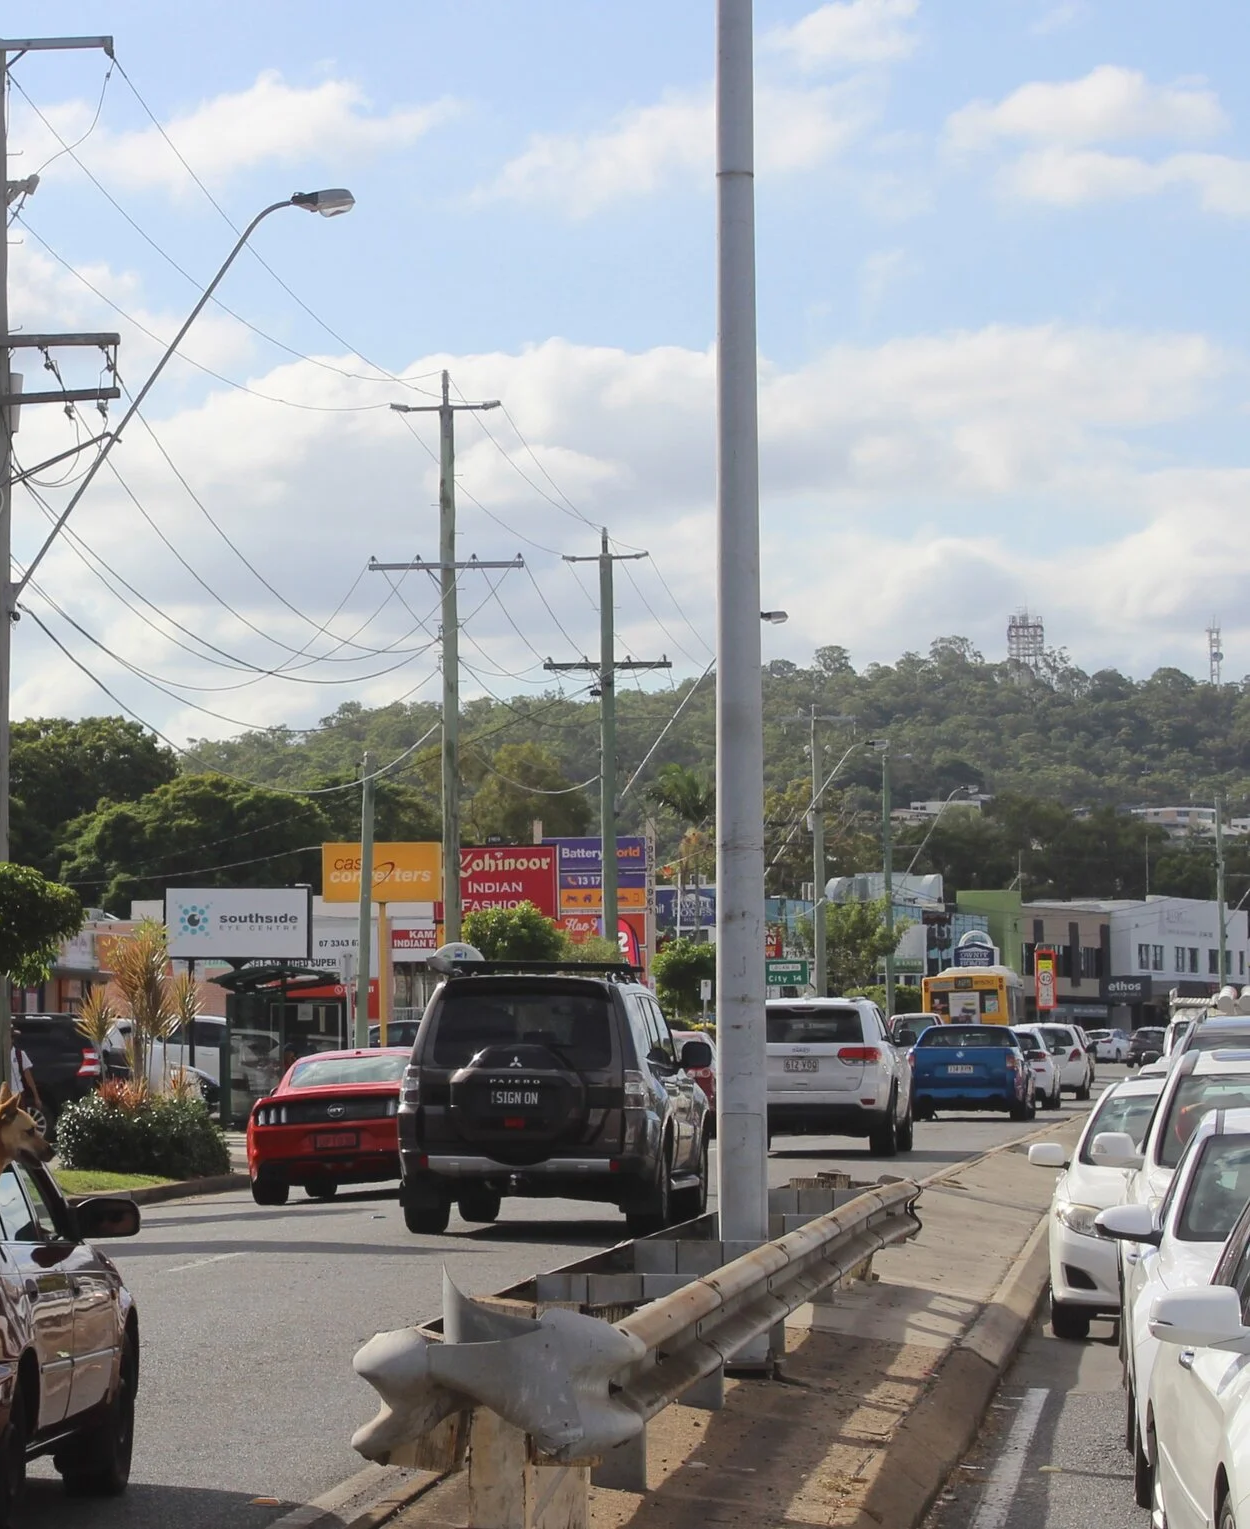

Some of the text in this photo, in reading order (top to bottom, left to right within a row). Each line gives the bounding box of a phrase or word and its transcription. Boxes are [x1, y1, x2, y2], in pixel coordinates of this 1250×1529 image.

[562, 847, 640, 860] Battery orld
[334, 858, 361, 870] cas
[330, 868, 431, 883] conerters
[578, 876, 588, 885] 13
[468, 881, 522, 893] INDIAN
[462, 899, 522, 911] FASHIO
[220, 913, 298, 924] southside
[394, 939, 426, 947] INDIAN
[311, 958, 337, 967] SUPER
[769, 975, 787, 983] City
[1108, 981, 1141, 991] ethos
[497, 1091, 521, 1104] SIGN
[525, 1091, 538, 1104] ON
